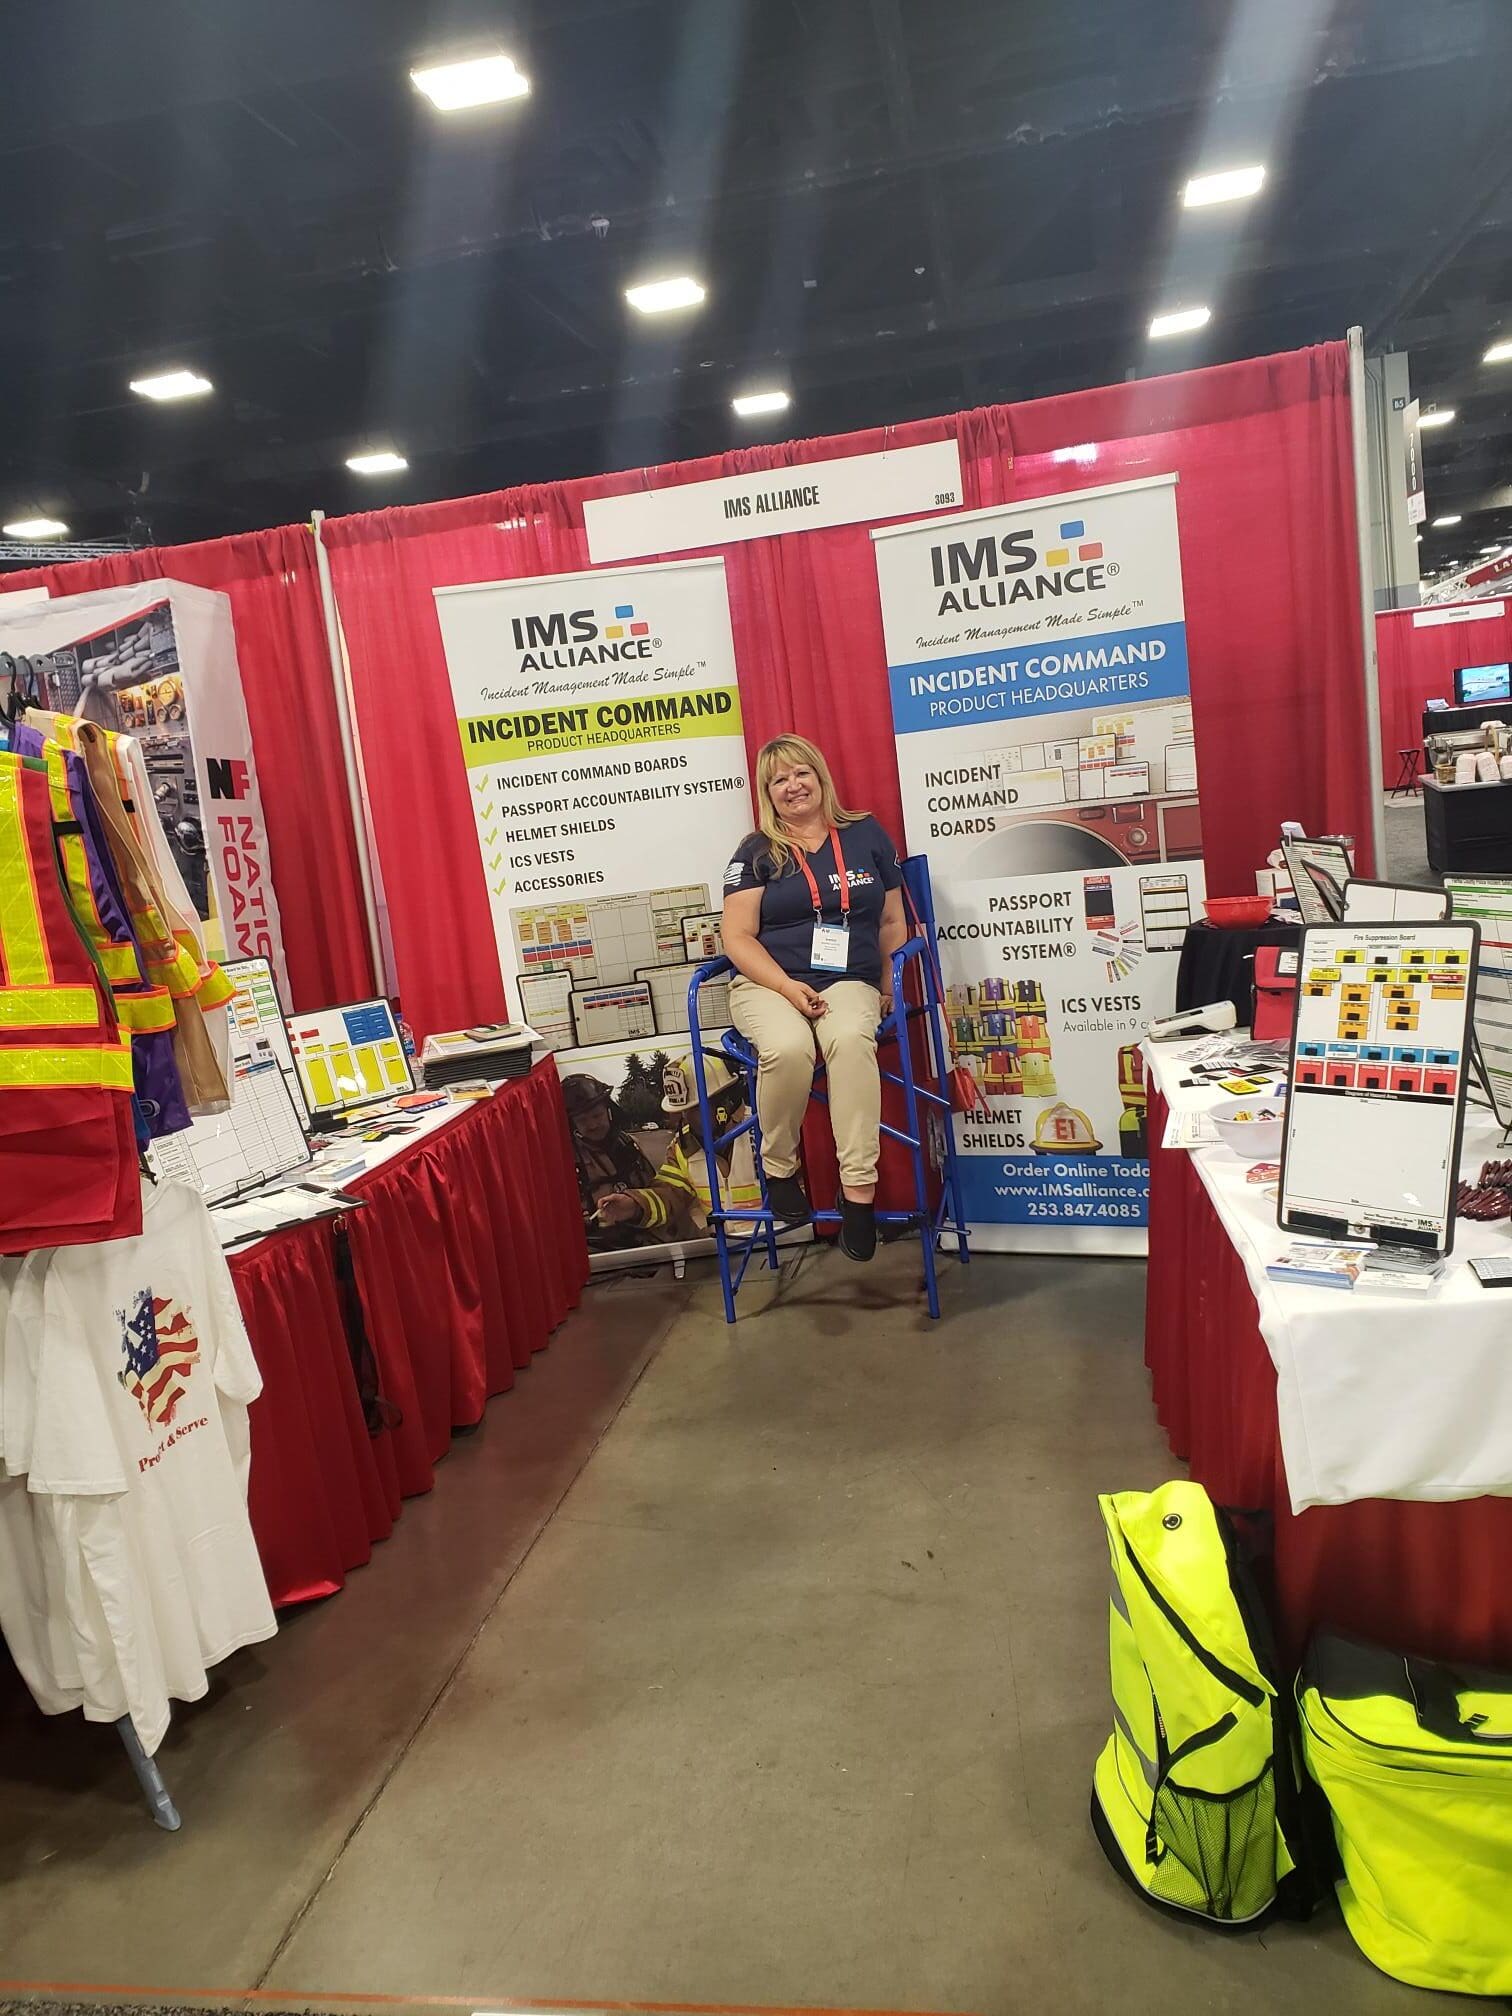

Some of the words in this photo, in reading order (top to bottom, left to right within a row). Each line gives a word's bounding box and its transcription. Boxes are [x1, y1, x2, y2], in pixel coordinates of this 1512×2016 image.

[723, 496, 752, 519] IMS
[755, 485, 820, 514] ALLIANCE
[934, 492, 955, 505] 3093
[930, 529, 1038, 587] IMS
[511, 609, 599, 650] IMS
[915, 636, 960, 649] Incident
[964, 620, 1041, 643] Management
[1045, 613, 1082, 628] Made
[909, 661, 1019, 696] INCIDENT
[1025, 640, 1166, 677] COMMAND
[480, 686, 529, 702] Incident
[532, 676, 610, 698] Management
[612, 670, 649, 684] Made
[930, 692, 1006, 717] PRODUCT
[1011, 671, 1149, 706] HEADQUARTERS
[468, 708, 589, 744] INCIDENT
[596, 691, 732, 728] COMMAND
[527, 734, 583, 751] PRODUCT
[587, 723, 681, 745] HEADQUARTERS
[206, 758, 250, 800] NF
[497, 771, 558, 790] INCIDENT
[561, 763, 631, 782] COMMAND
[634, 755, 688, 773] BOARDS
[925, 764, 1001, 788] INCIDENT
[501, 798, 570, 818] PASSPORT
[572, 784, 681, 809] ACCOUNTABILITY
[683, 776, 745, 796] SYSTEM®
[927, 788, 1019, 813] COMMAND
[505, 825, 558, 843] HELMET
[560, 818, 616, 836] SHIELDS
[930, 817, 996, 838] BOARDS
[510, 855, 532, 868] ICS
[534, 849, 575, 865] VESTS
[237, 816, 276, 968] NATIO
[514, 870, 604, 894] ACCESSORIES
[989, 891, 1072, 912] PASSPORT
[936, 917, 1074, 941] ACCOUNTABILITY
[1365, 934, 1398, 942] Suppression
[1002, 942, 1077, 962] SYSTEM®
[1061, 998, 1087, 1013] ICS
[1091, 995, 1141, 1012] VESTS
[1063, 1018, 1113, 1032] Available
[1117, 1020, 1126, 1030] in
[1129, 1018, 1137, 1029] 9
[1140, 1021, 1149, 1030] c
[964, 1110, 1022, 1124] HELMET
[1055, 1118, 1076, 1140] E1
[962, 1134, 1025, 1148] SHIELDS
[1003, 1163, 1050, 1177] Order
[1053, 1163, 1108, 1177] Online
[1027, 1203, 1141, 1217] 253.847.4085
[176, 1417, 209, 1439] Serve
